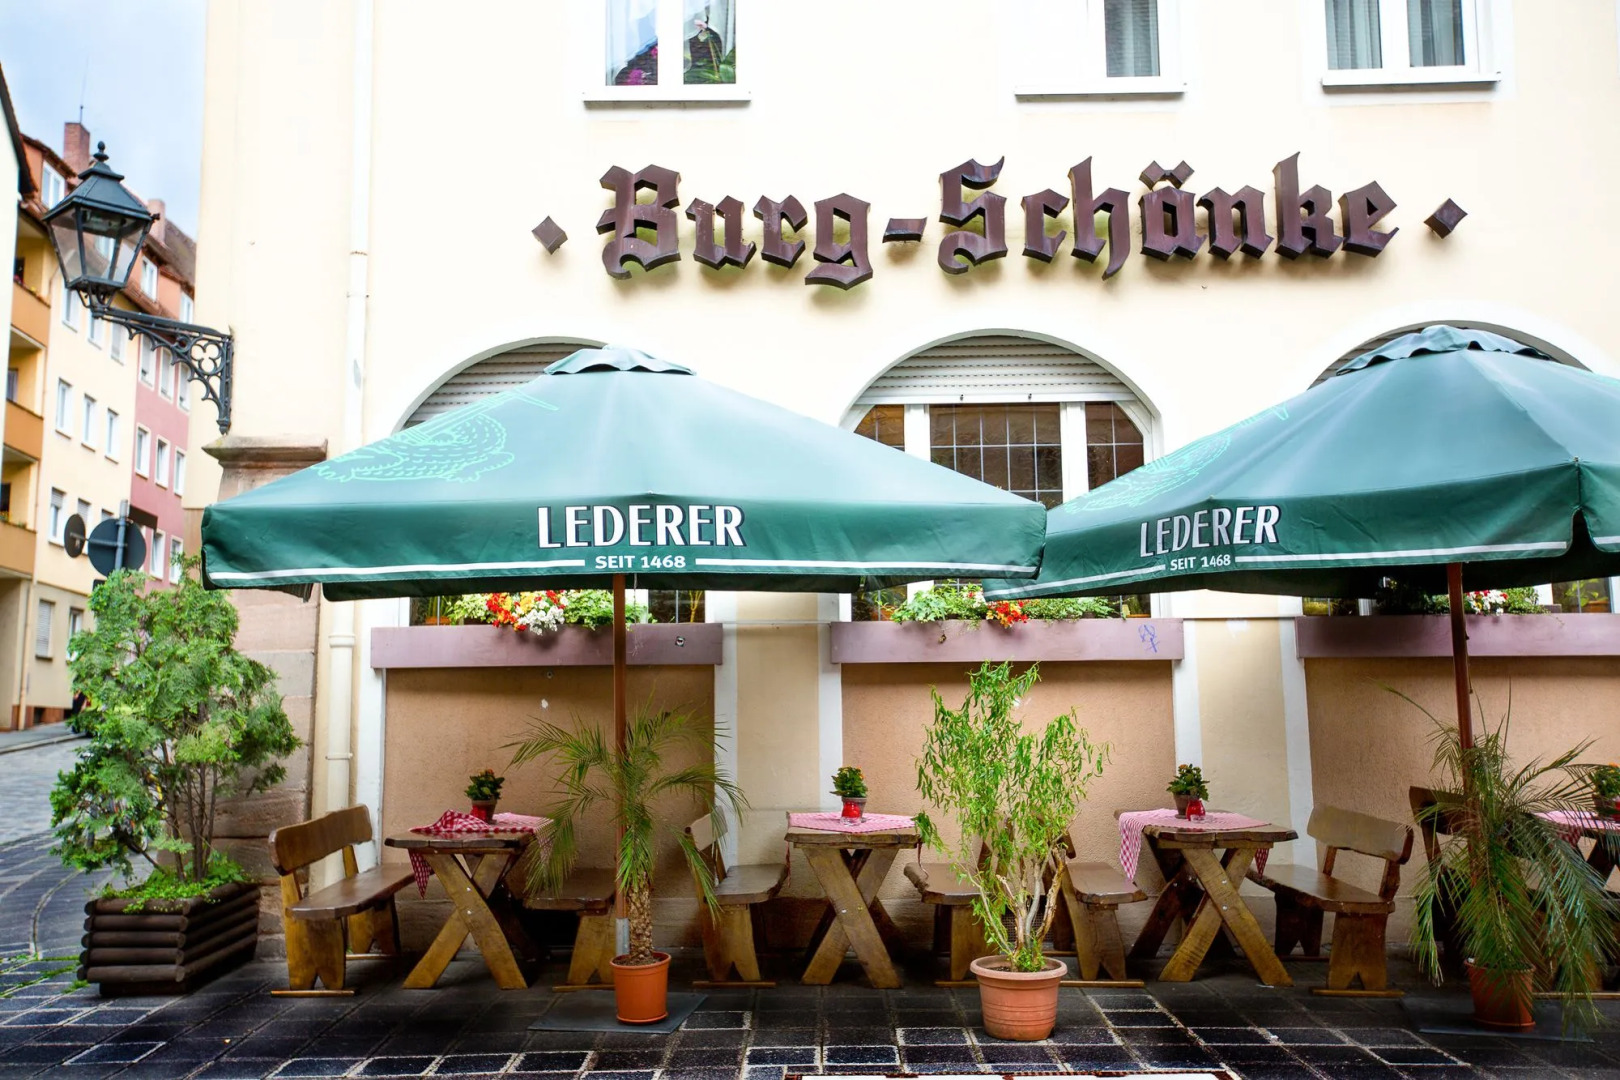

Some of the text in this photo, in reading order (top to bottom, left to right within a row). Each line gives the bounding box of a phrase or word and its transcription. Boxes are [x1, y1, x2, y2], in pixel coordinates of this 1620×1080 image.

[537, 504, 747, 549] LEDERER
[1139, 505, 1281, 558] LEDERER
[595, 555, 686, 569] SEIT 1468
[1169, 554, 1231, 571] SEIT 1468
